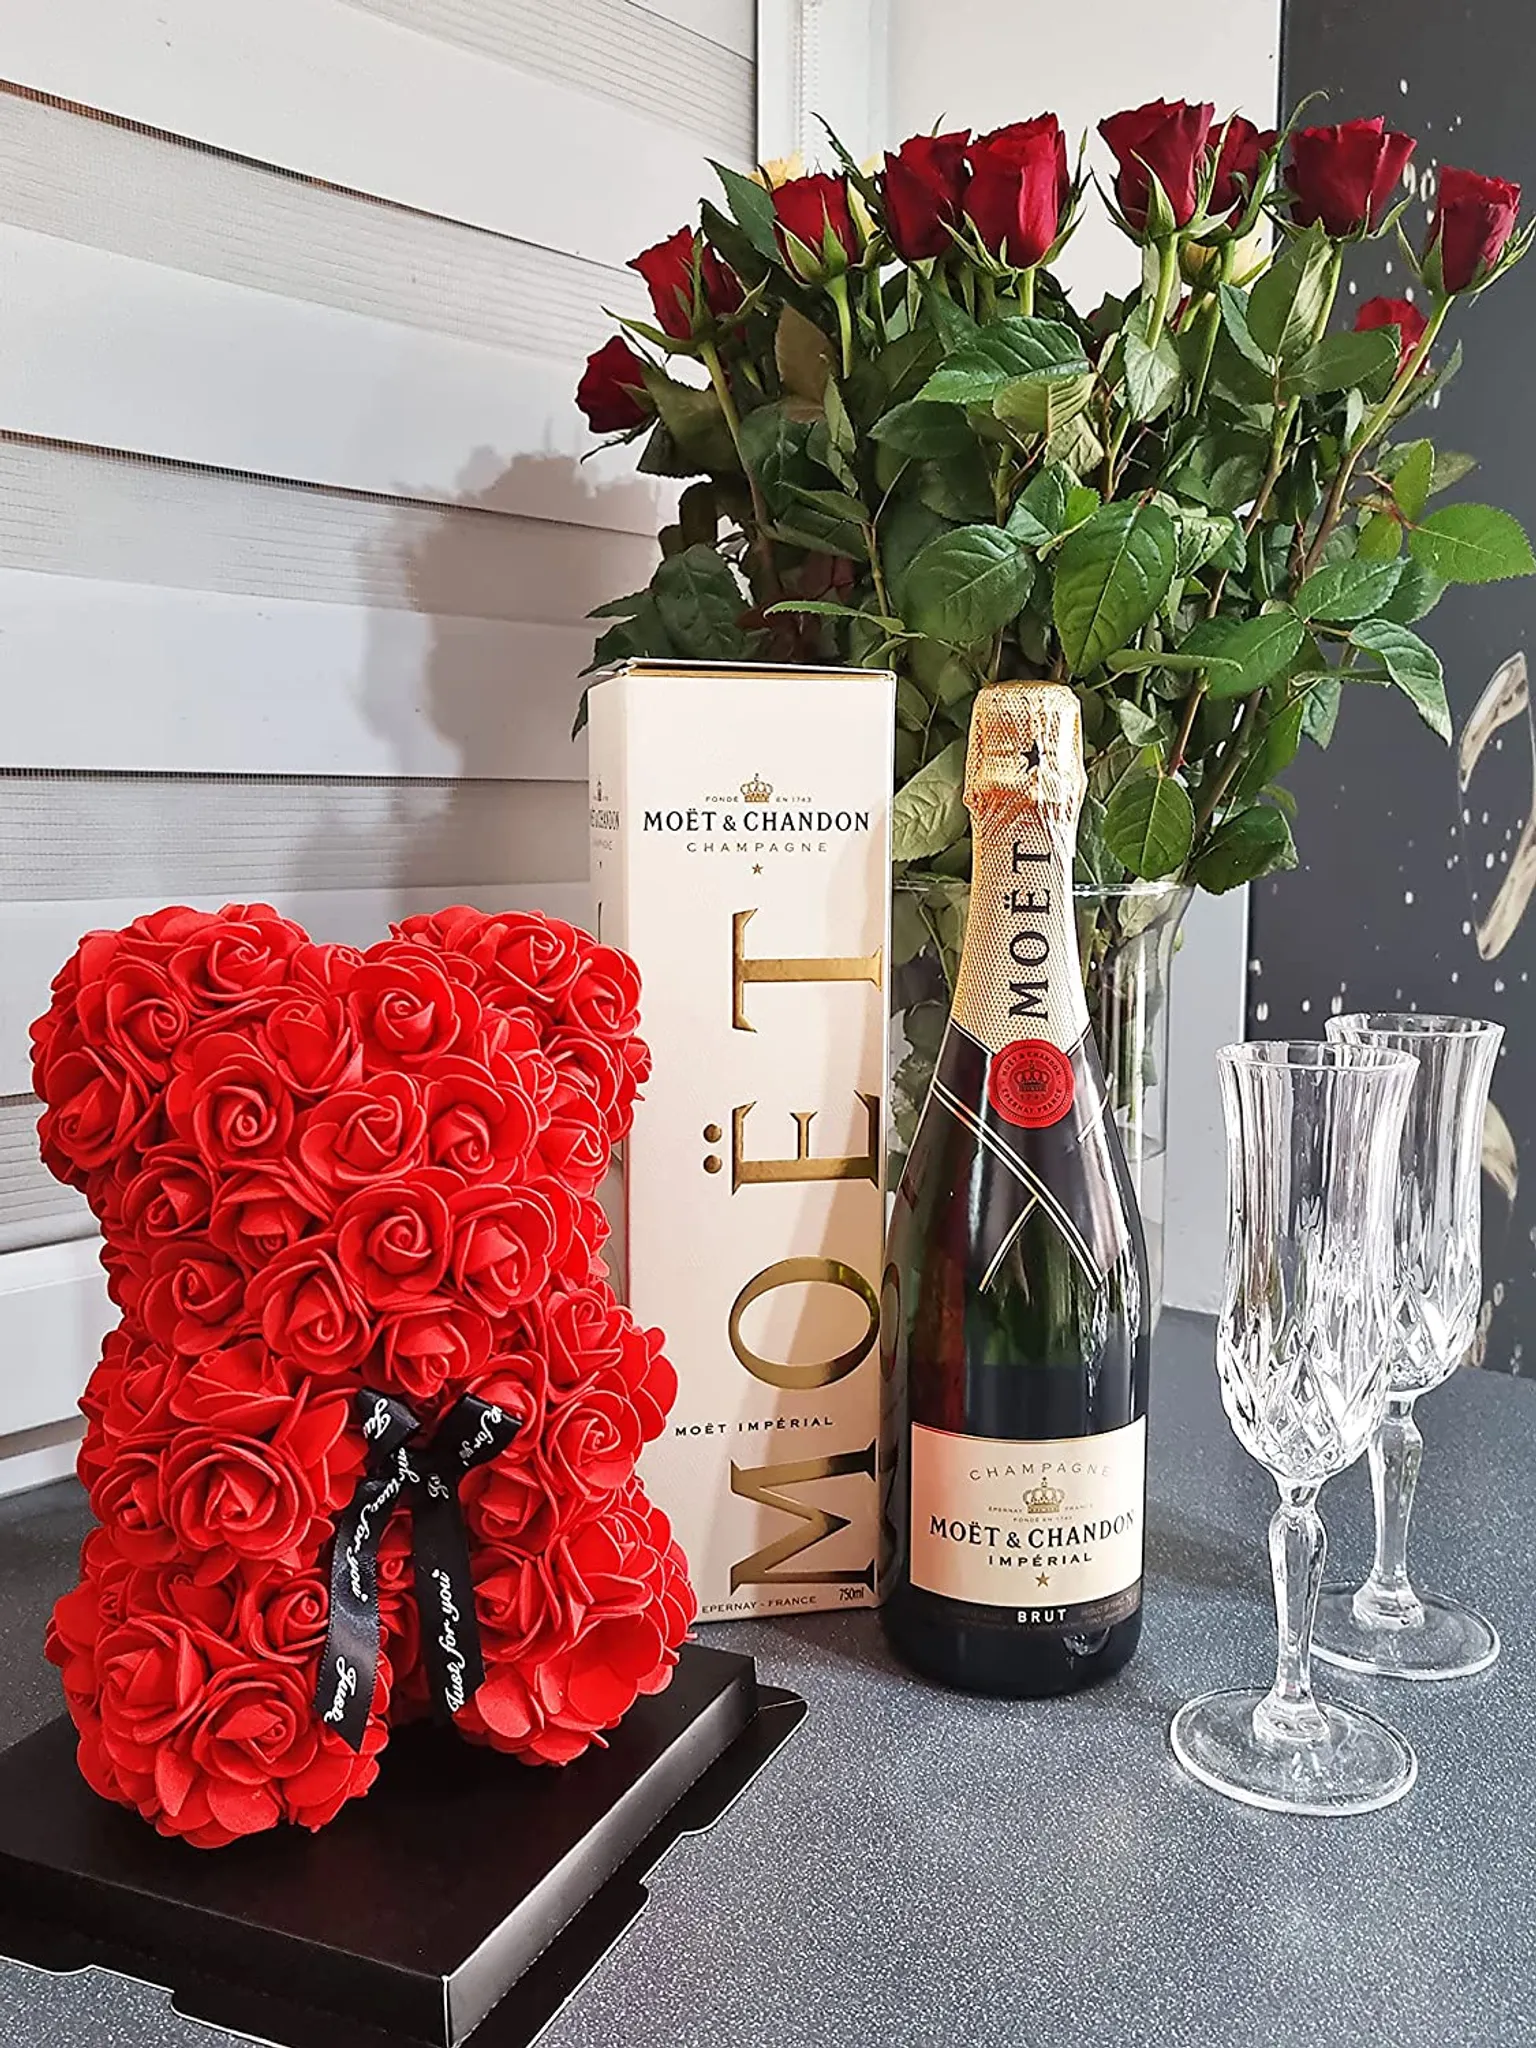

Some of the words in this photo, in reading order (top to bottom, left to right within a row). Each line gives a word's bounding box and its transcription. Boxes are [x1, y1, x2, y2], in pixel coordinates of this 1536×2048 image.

[643, 808, 717, 832] MOËT
[722, 814, 737, 832] &
[743, 811, 870, 832] CHANDON
[686, 842, 827, 853] CHAMPAGNE
[1003, 840, 1052, 1022] MOËT
[703, 908, 882, 1596] MOËT
[674, 1422, 728, 1437] MOËT
[738, 1416, 834, 1433] IMPÉRIAL
[969, 1463, 1112, 1481] CHAMPAGNE
[929, 1515, 1001, 1547] MOËT
[1006, 1531, 1022, 1549] &
[1027, 1509, 1135, 1550] CHANDON
[988, 1552, 1093, 1568] IMPÉRIAL
[346, 1546, 363, 1599] you
[439, 1571, 460, 1622] you
[768, 1596, 817, 1608] FRANCE
[839, 1586, 865, 1602] 750ml
[1017, 1608, 1067, 1623] BRUT
[323, 1656, 357, 1722] Just
